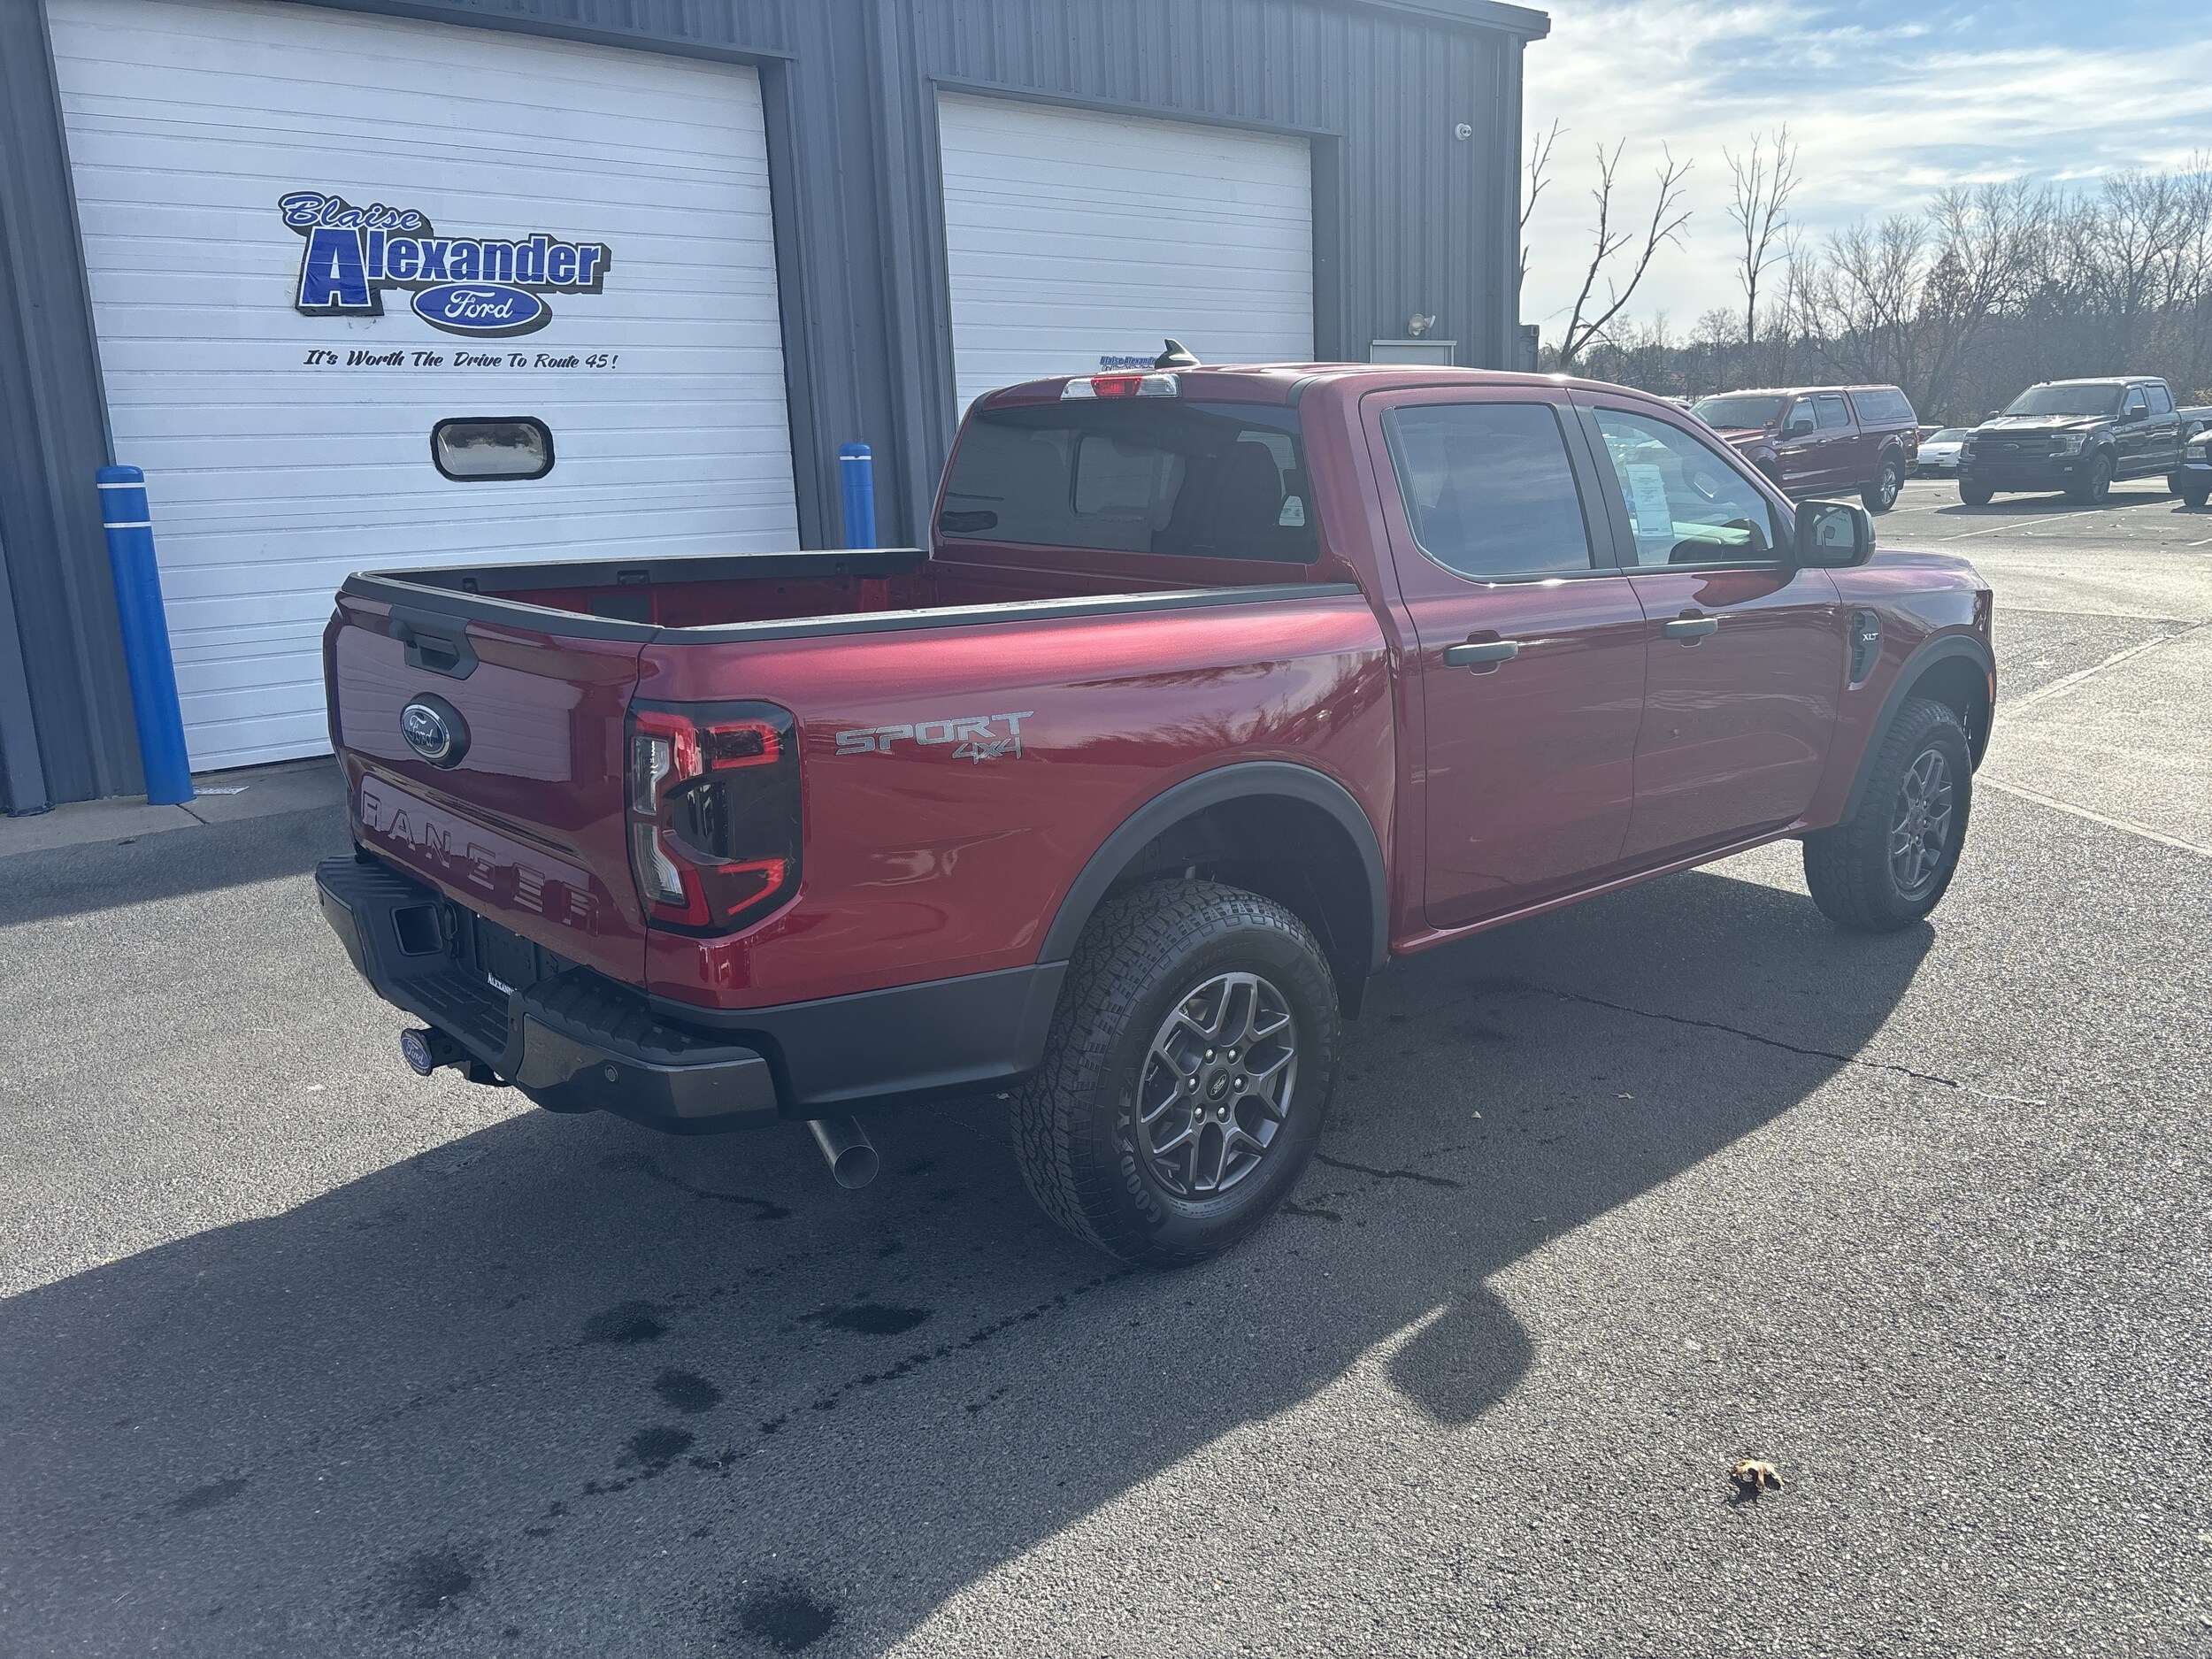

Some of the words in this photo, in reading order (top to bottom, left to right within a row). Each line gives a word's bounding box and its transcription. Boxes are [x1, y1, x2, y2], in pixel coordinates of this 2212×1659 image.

[279, 194, 422, 229] Blaise
[297, 227, 603, 308] Alexander
[444, 289, 514, 320] Ford
[303, 349, 339, 365] It's
[346, 350, 406, 367] Worth
[411, 350, 444, 367] The
[452, 351, 503, 367] Drive
[506, 353, 527, 368] To
[534, 353, 580, 369] Route
[1862, 633, 1879, 641] XLT
[409, 714, 434, 748] Ford
[834, 710, 1034, 756] SPORT
[361, 789, 600, 937] RANGER
[406, 1039, 426, 1066] Ford
